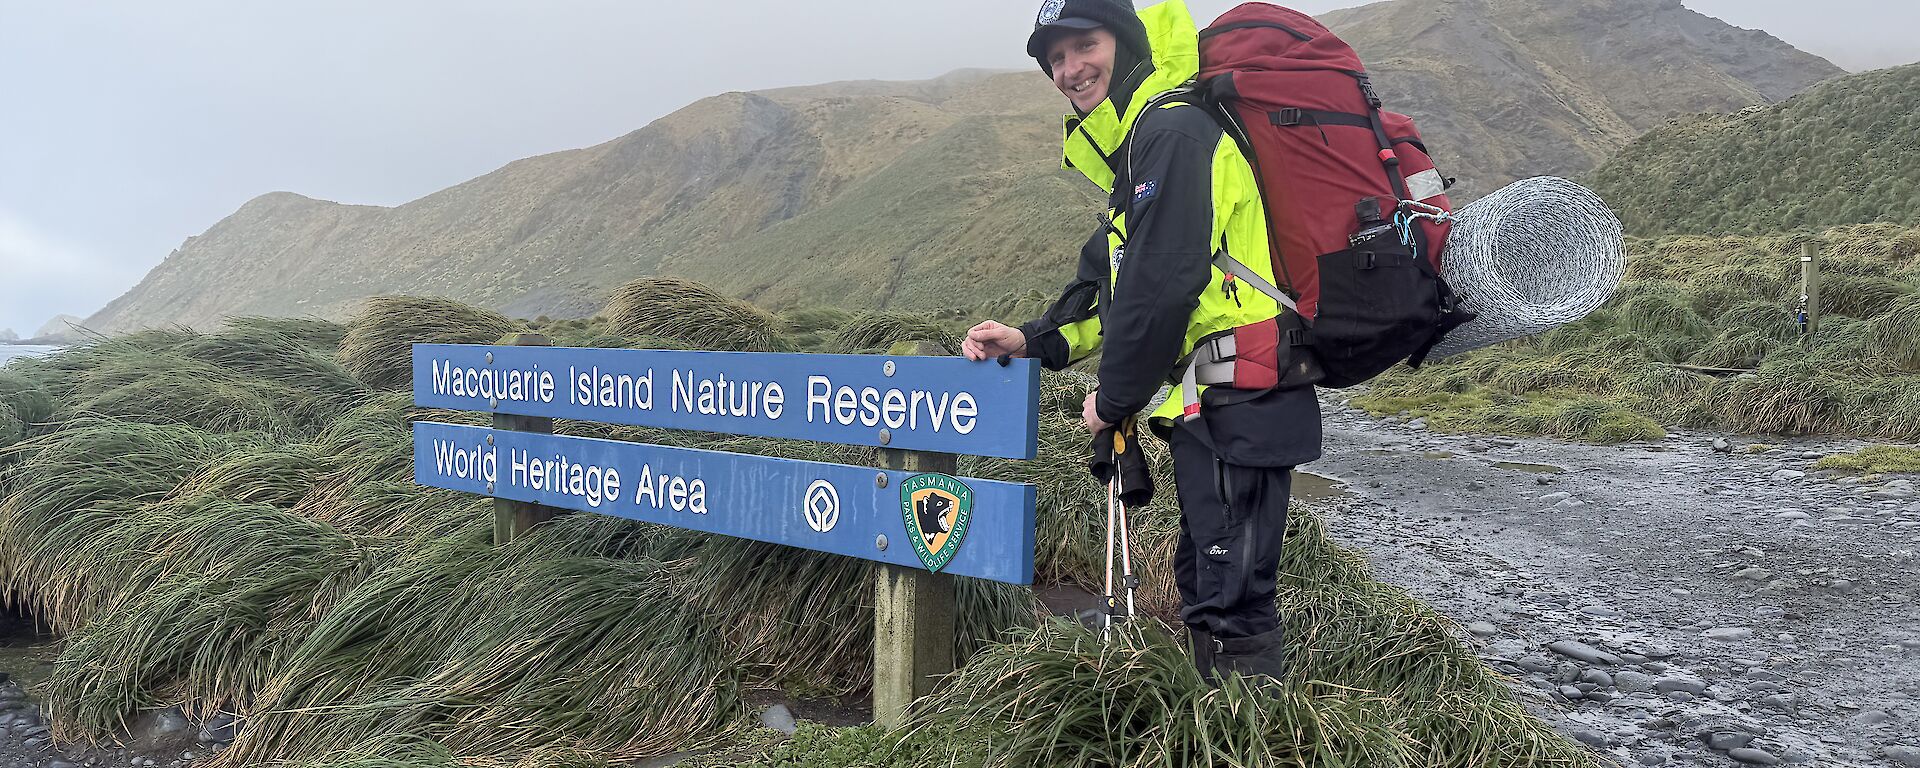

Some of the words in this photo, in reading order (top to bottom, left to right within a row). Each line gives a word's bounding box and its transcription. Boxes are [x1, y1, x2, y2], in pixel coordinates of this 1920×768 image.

[432, 358, 555, 403] Macquarie
[569, 365, 654, 411] Island
[671, 368, 784, 420] Nature
[806, 375, 979, 435] Reserve
[433, 438, 497, 483] World
[511, 447, 621, 508] Heritage
[635, 463, 708, 514] Area
[903, 476, 968, 501] TASMANIA
[903, 500, 916, 534] PARKS
[912, 535, 919, 543] &
[916, 543, 950, 568] WILDLIFE
[948, 509, 968, 550] SERVICE
